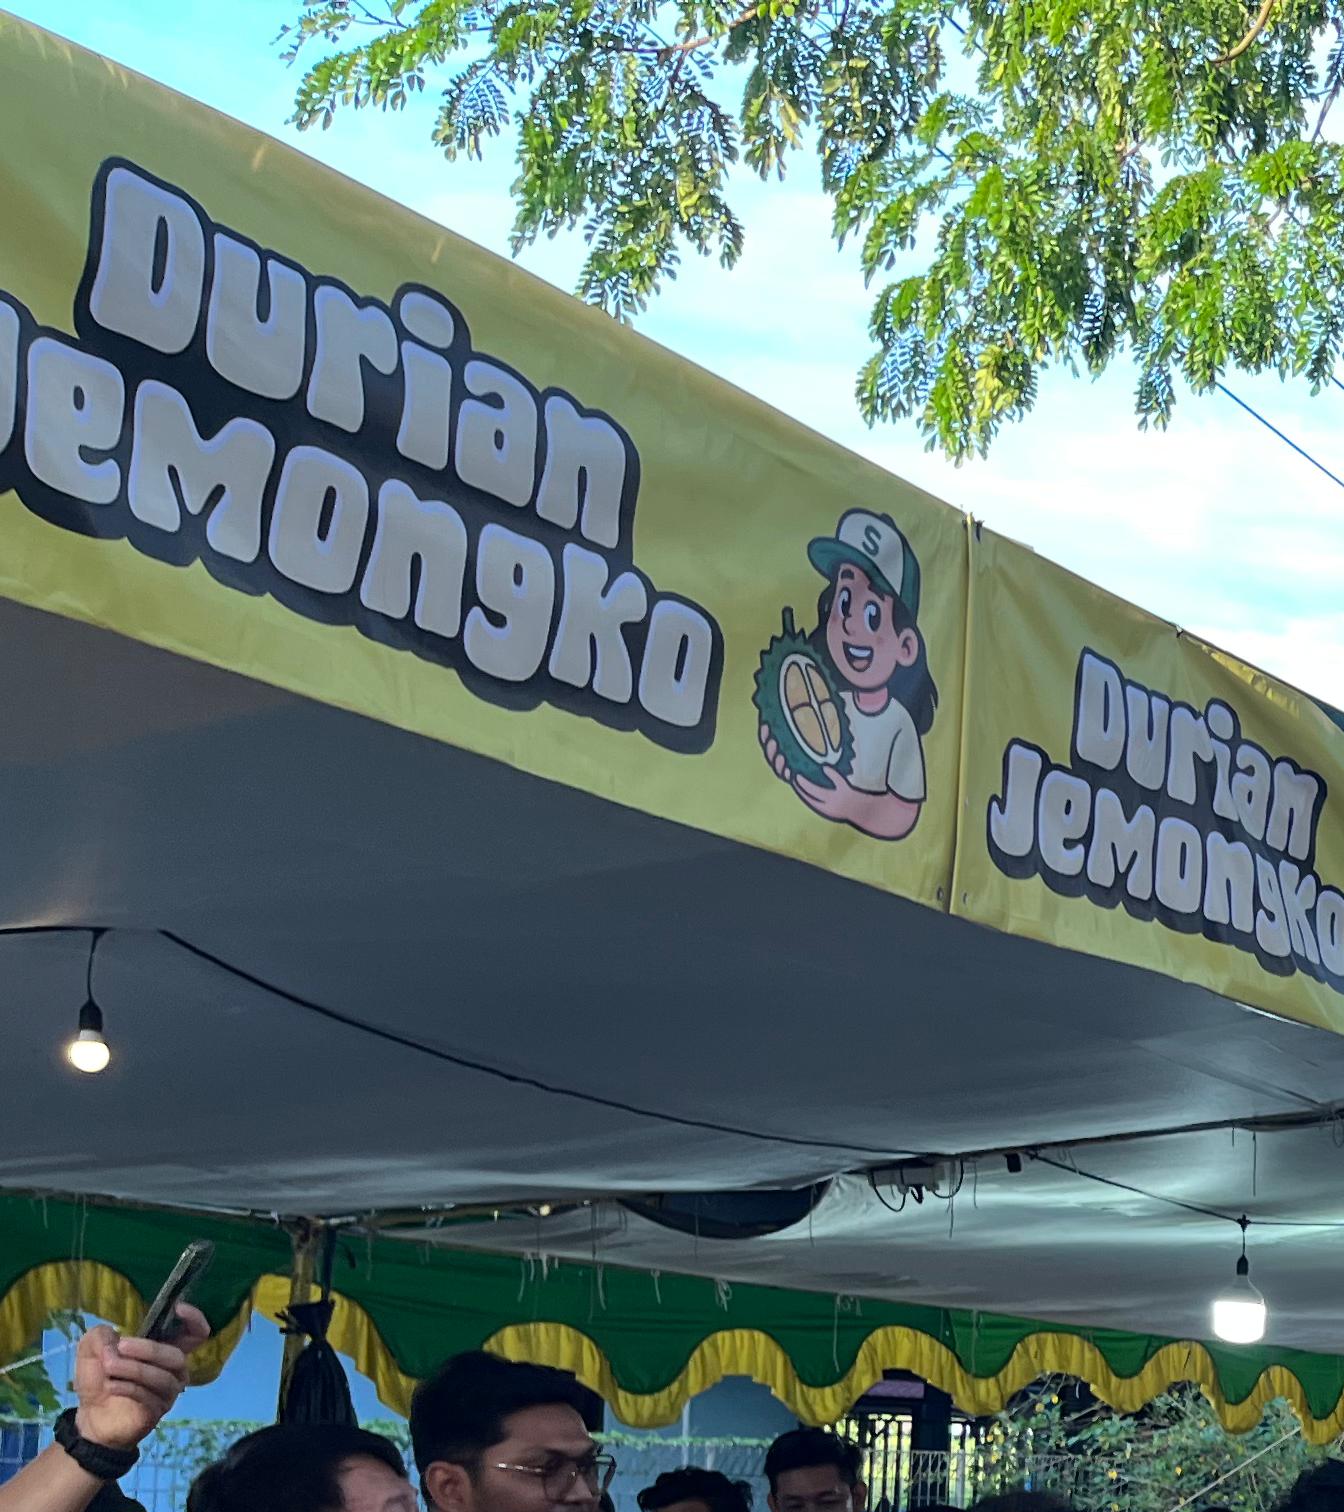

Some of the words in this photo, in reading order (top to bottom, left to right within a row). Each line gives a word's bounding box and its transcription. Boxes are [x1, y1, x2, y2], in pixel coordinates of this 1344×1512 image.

[0, 300, 715, 729] emongko
[88, 164, 630, 550] Durian
[1075, 652, 1320, 862] Durian
